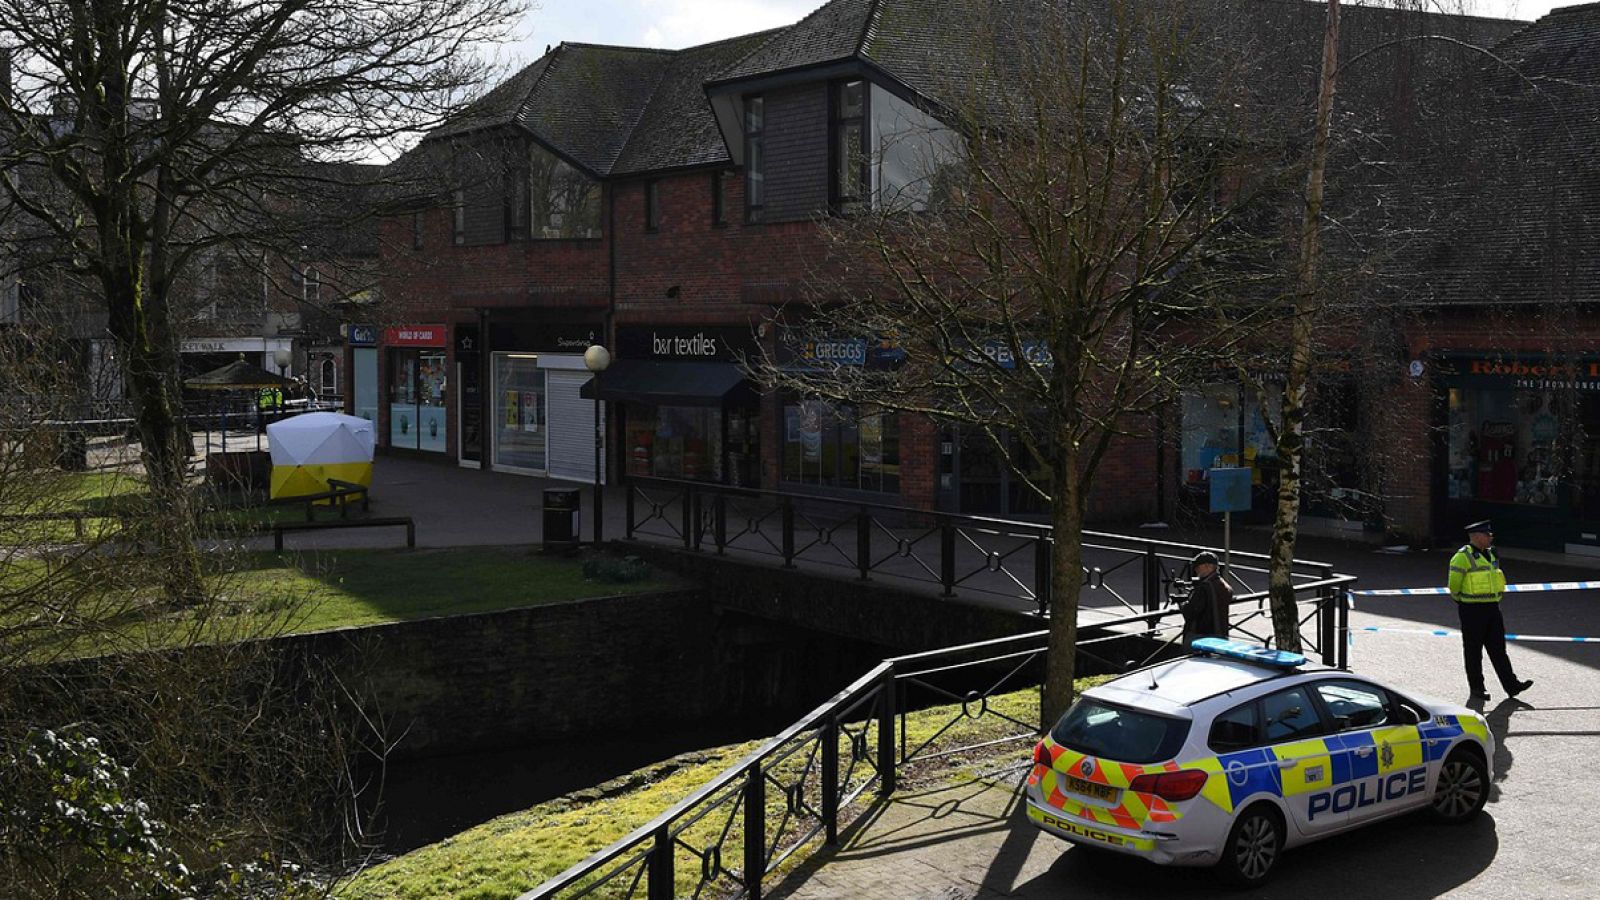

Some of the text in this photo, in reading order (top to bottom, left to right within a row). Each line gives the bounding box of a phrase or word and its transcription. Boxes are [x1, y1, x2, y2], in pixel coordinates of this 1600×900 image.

[674, 332, 716, 355] textiles
[815, 343, 861, 359] GREGGS
[1309, 767, 1426, 821] POLICE
[1043, 815, 1123, 846] POLICE
